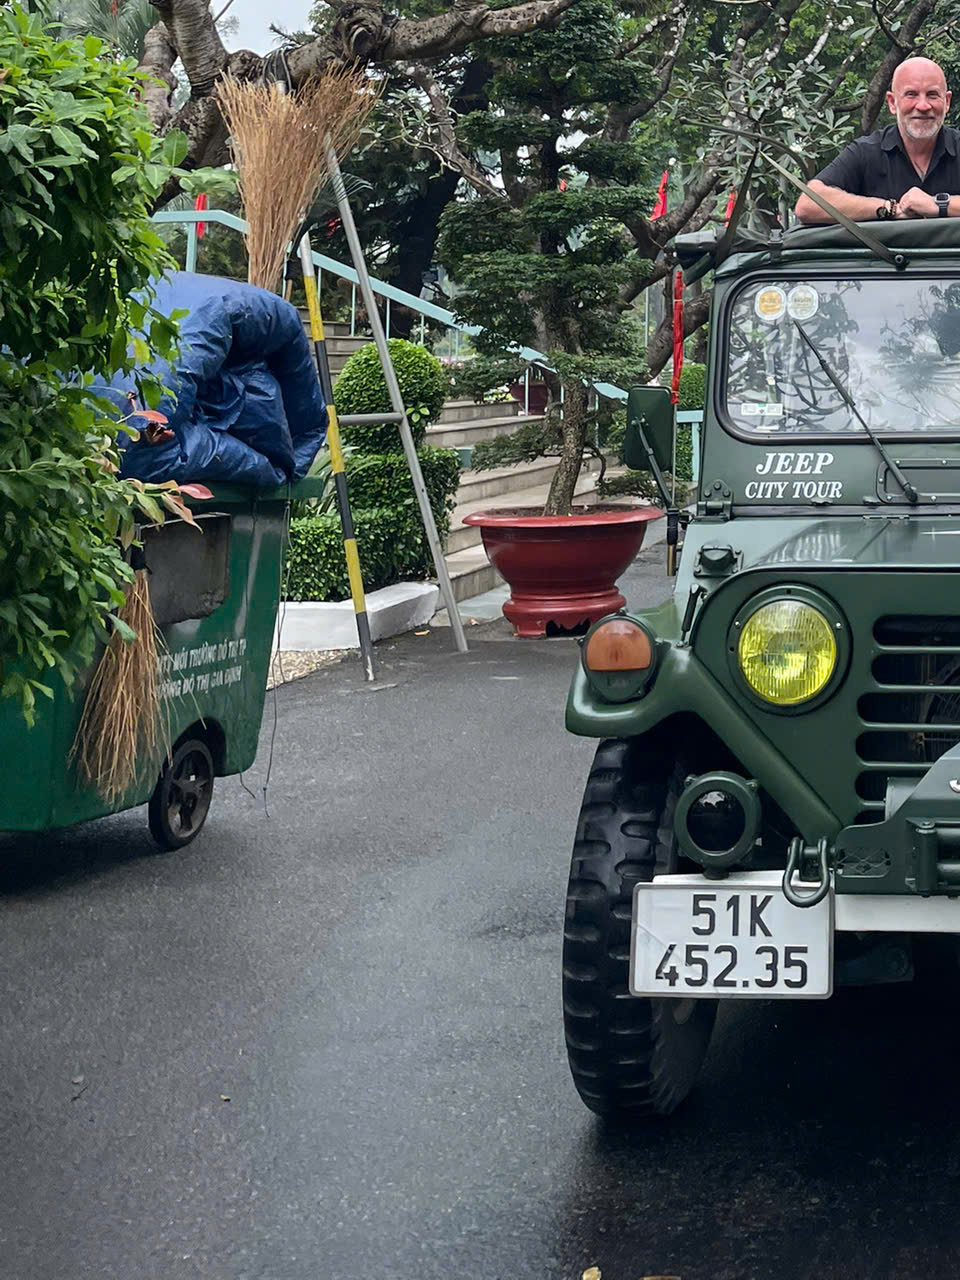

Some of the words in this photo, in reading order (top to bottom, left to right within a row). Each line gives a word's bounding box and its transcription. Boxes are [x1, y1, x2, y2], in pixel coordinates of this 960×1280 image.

[755, 452, 834, 475] JEEP
[745, 481, 789, 499] CITY
[792, 481, 843, 499] TOUR
[692, 893, 774, 937] 51K
[655, 943, 809, 989] 452.35
